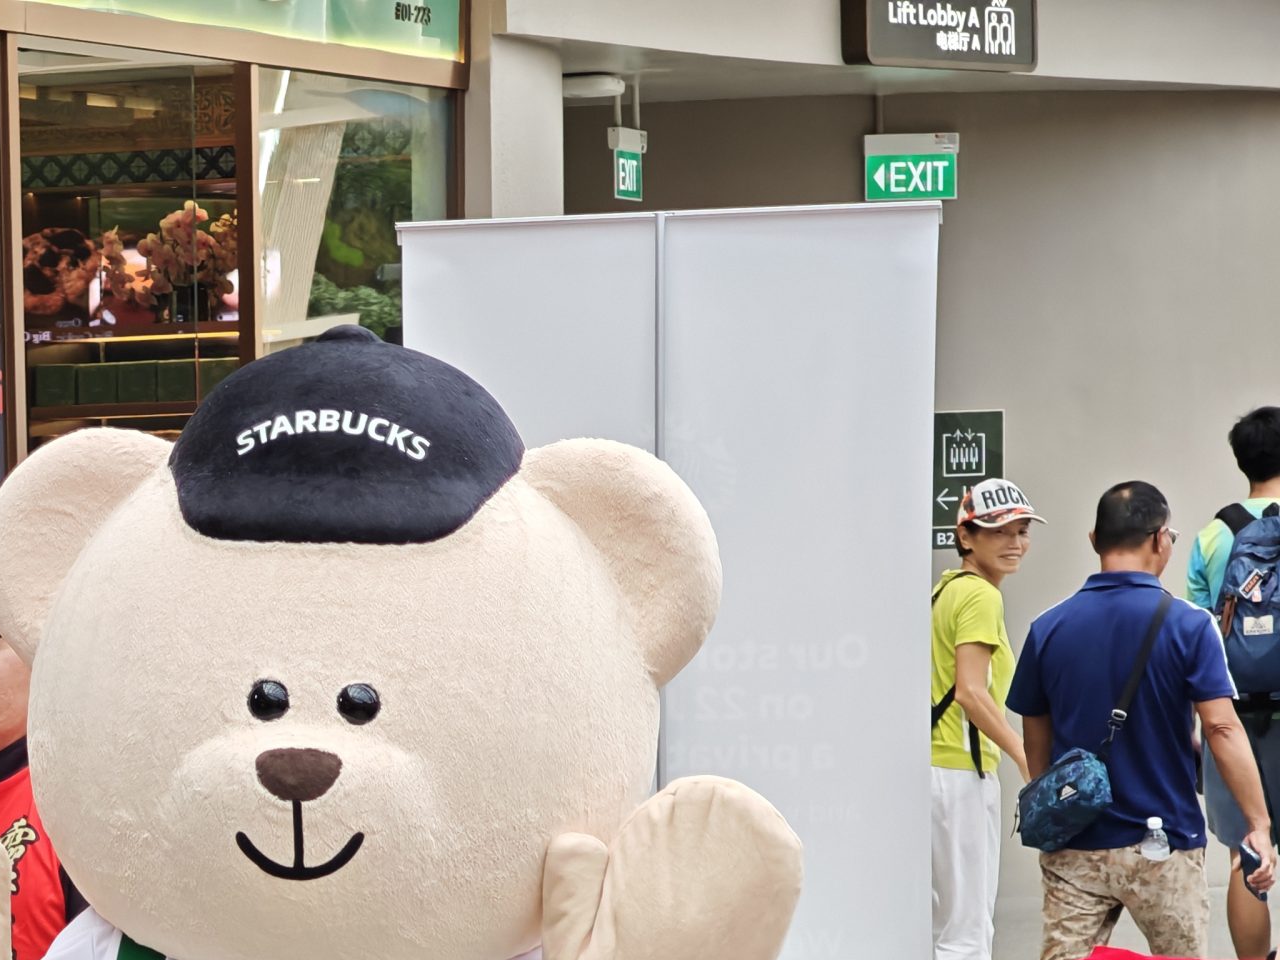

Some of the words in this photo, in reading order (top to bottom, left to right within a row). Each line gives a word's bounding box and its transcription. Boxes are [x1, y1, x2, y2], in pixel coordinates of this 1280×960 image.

[888, 2, 916, 25] Lift
[918, 4, 966, 31] Lobby
[968, 7, 980, 28] A
[971, 34, 981, 51] A
[619, 158, 638, 192] EXIT
[889, 161, 949, 193] EXIT
[236, 409, 431, 460] STARBUCKS
[936, 532, 956, 546] B2
